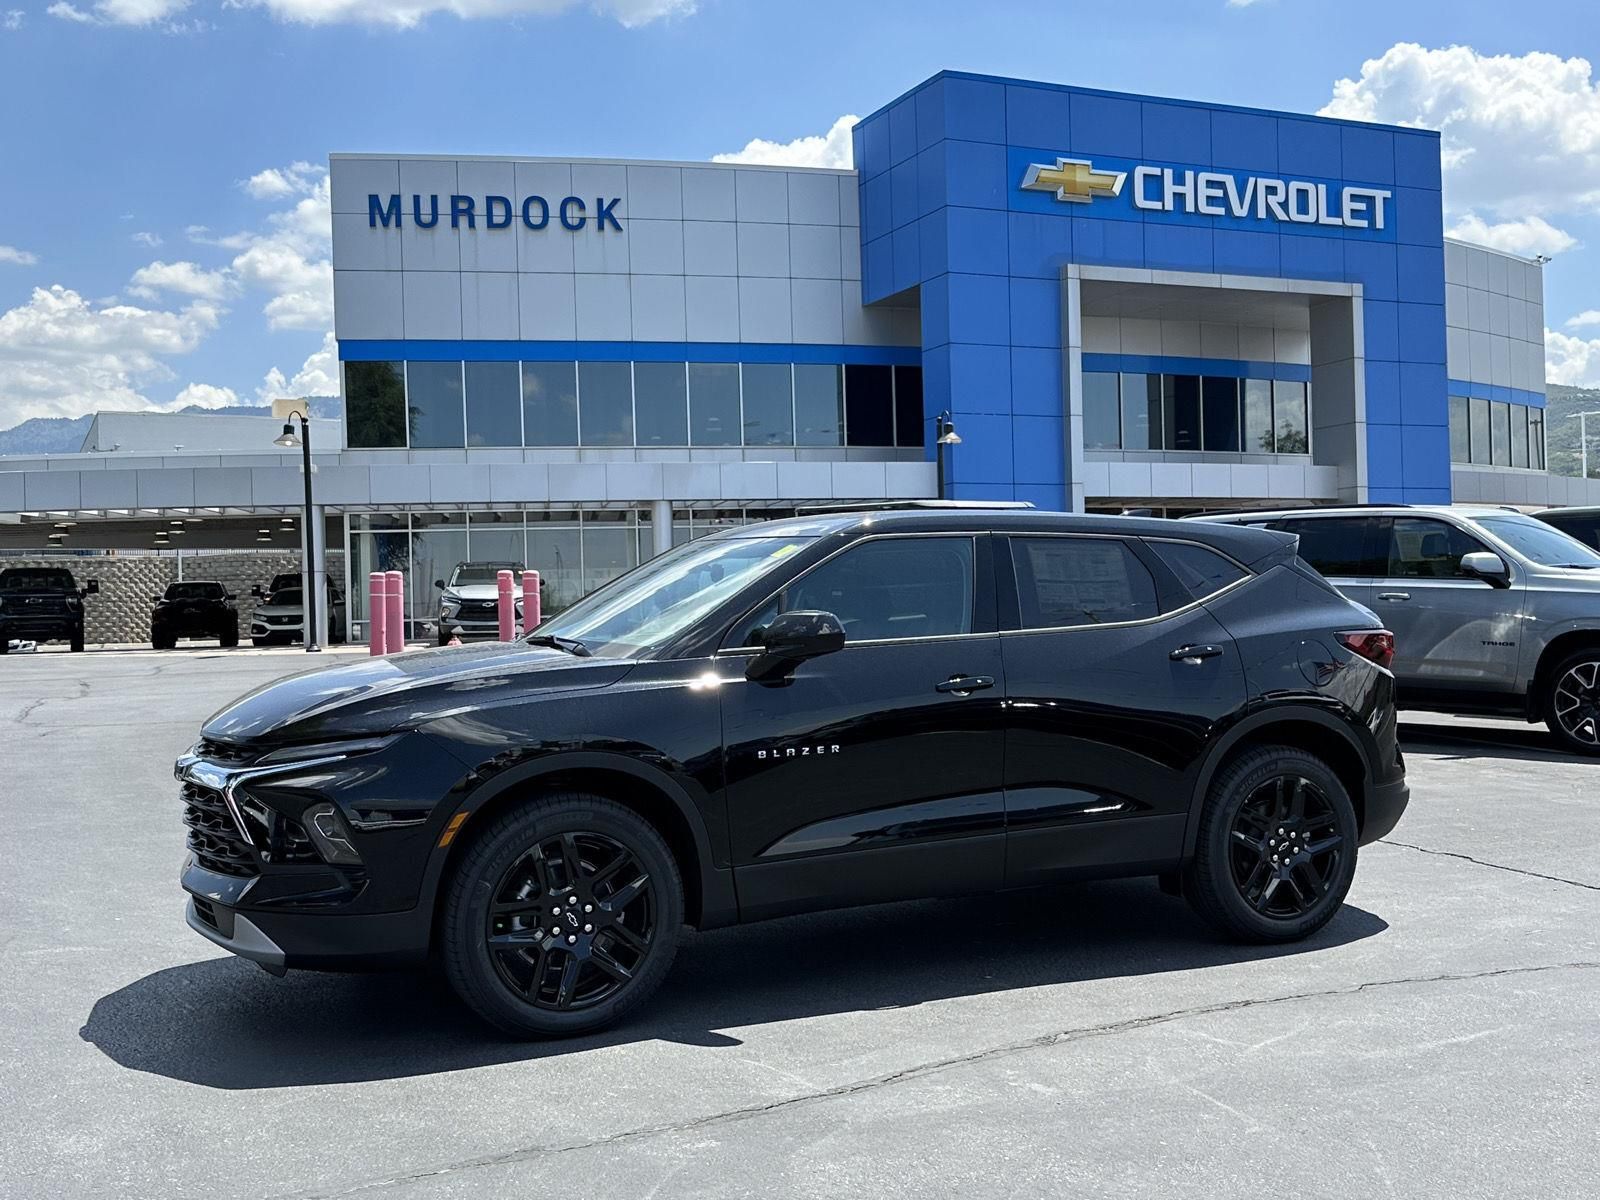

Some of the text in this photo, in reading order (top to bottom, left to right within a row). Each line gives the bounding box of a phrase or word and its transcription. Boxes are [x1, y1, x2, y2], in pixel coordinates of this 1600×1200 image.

[367, 193, 624, 233] MURDOCK
[1133, 164, 1392, 230] CHEVROLET
[757, 744, 840, 759] BLAZER
